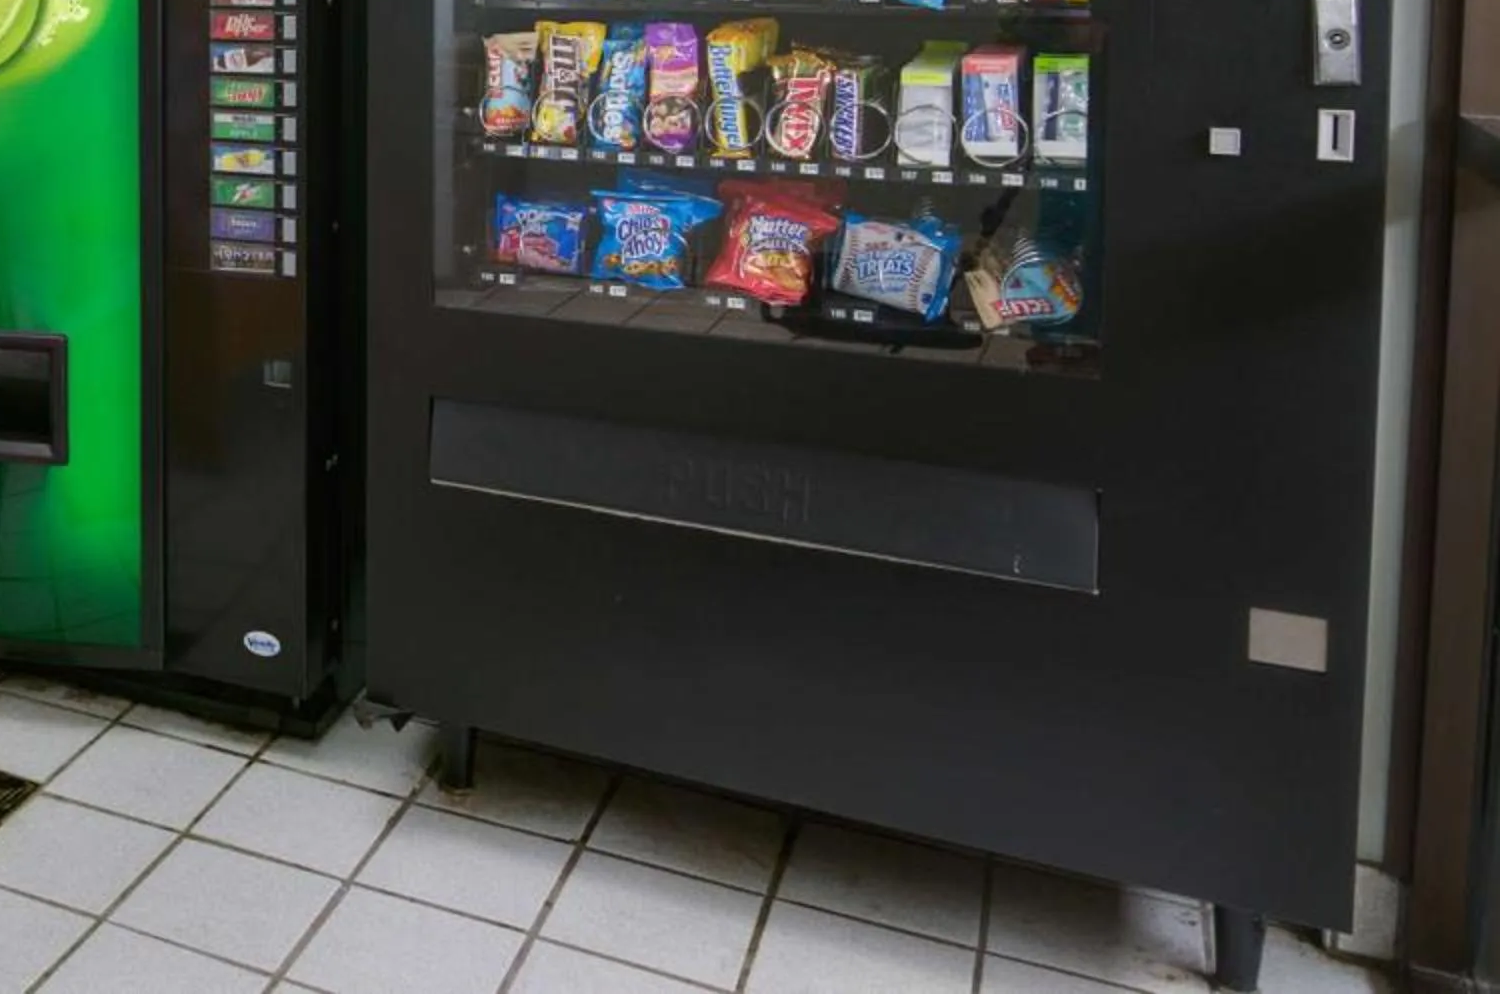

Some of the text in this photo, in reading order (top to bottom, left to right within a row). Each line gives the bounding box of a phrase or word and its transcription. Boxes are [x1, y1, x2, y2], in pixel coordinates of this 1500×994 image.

[604, 51, 631, 142] Skittles
[618, 215, 660, 241] Chips
[751, 214, 809, 238] Nutter
[858, 260, 915, 278] TREATS
